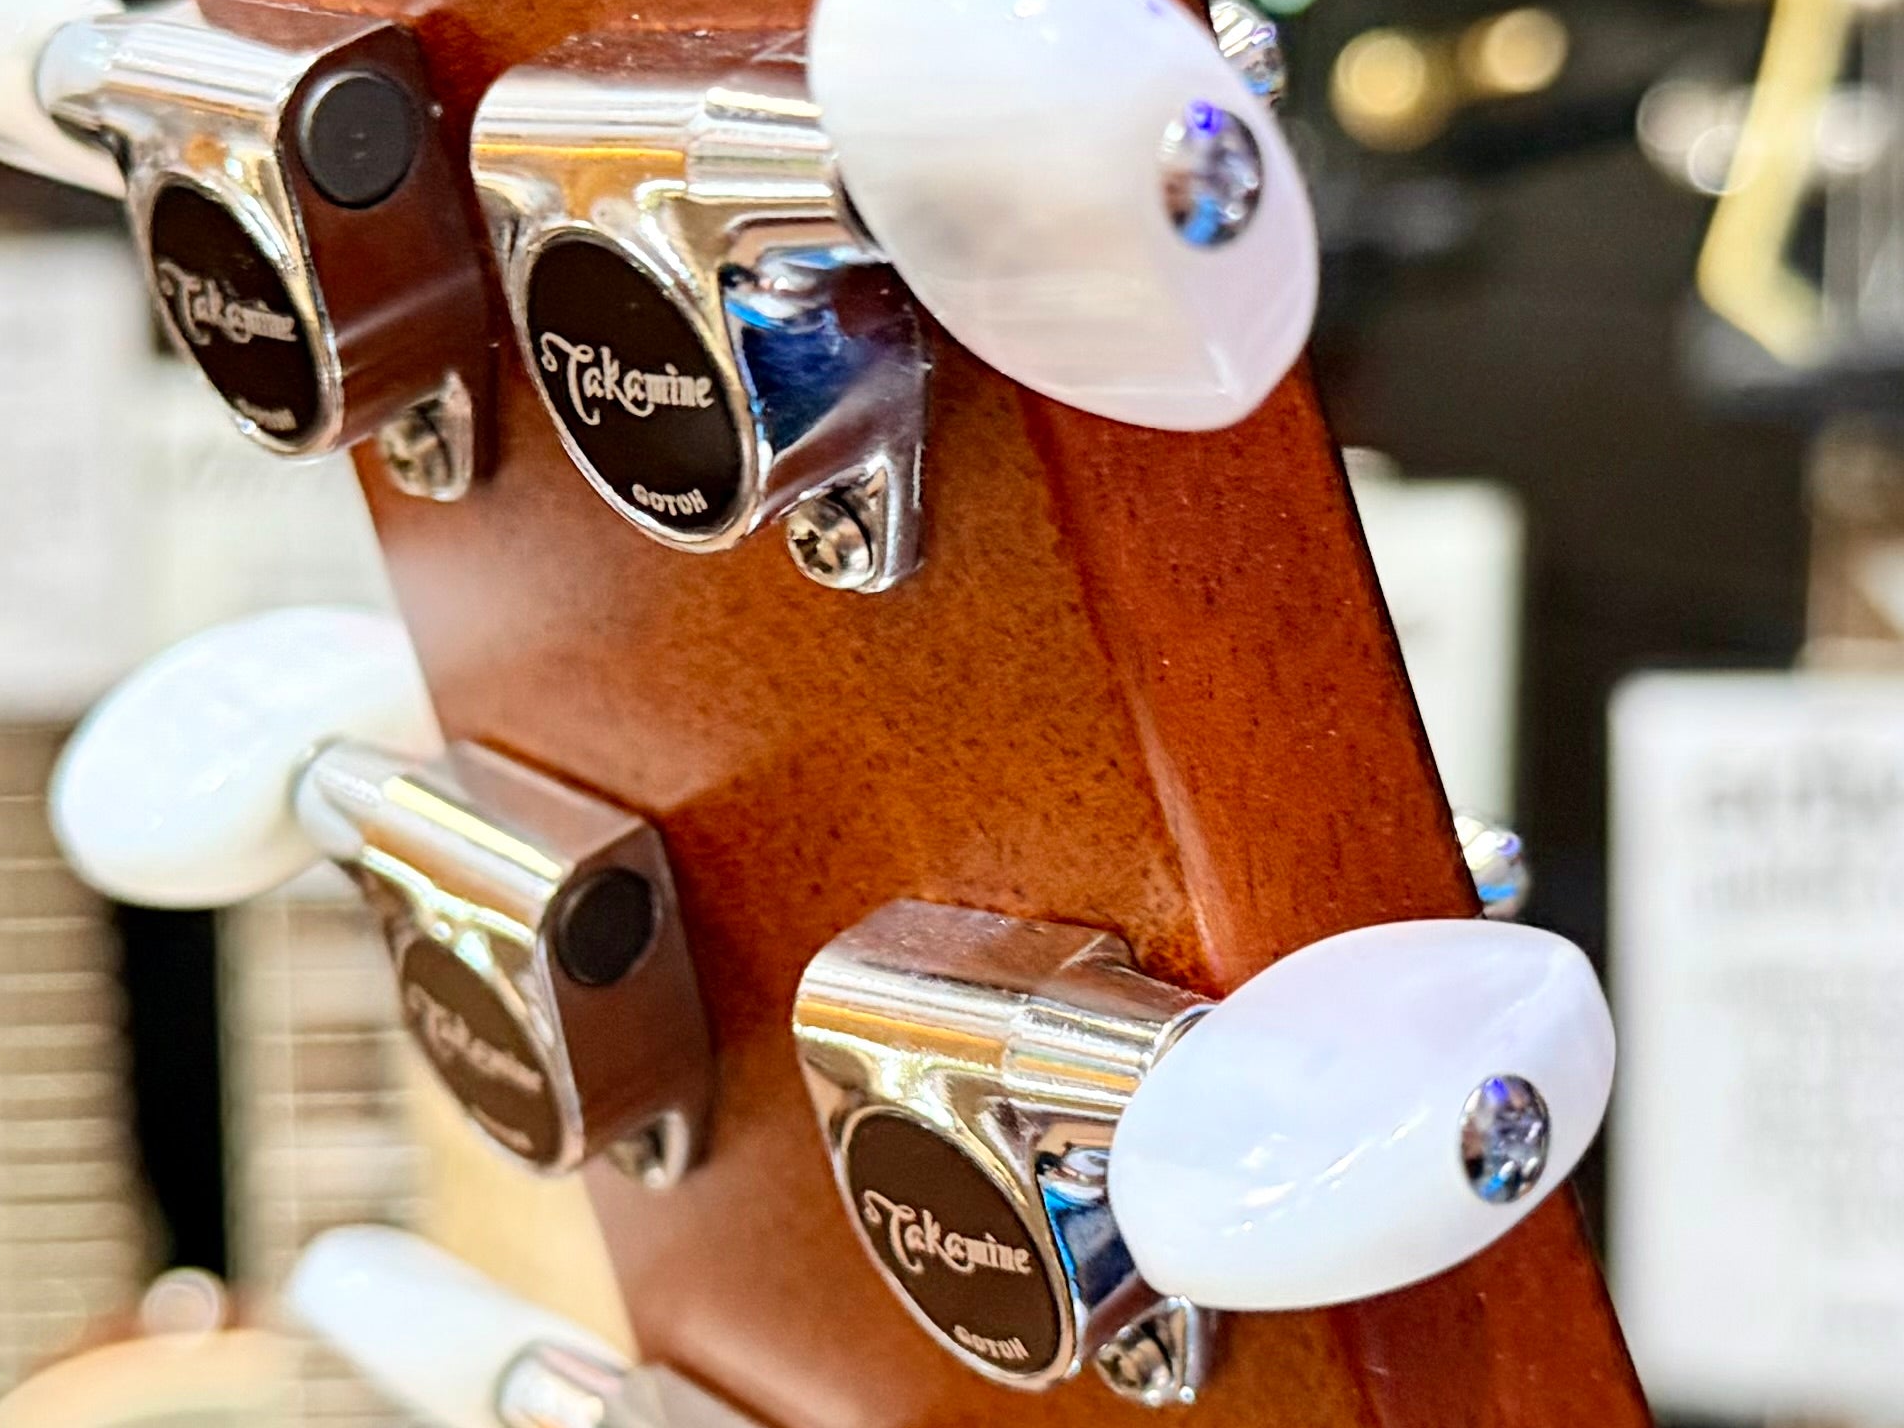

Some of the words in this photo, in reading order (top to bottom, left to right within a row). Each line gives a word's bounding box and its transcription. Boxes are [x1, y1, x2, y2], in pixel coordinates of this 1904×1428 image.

[158, 261, 298, 344] Takamine
[541, 332, 714, 425] Takamine
[631, 484, 708, 516] GOTOH
[863, 1189, 1032, 1274] Takamine
